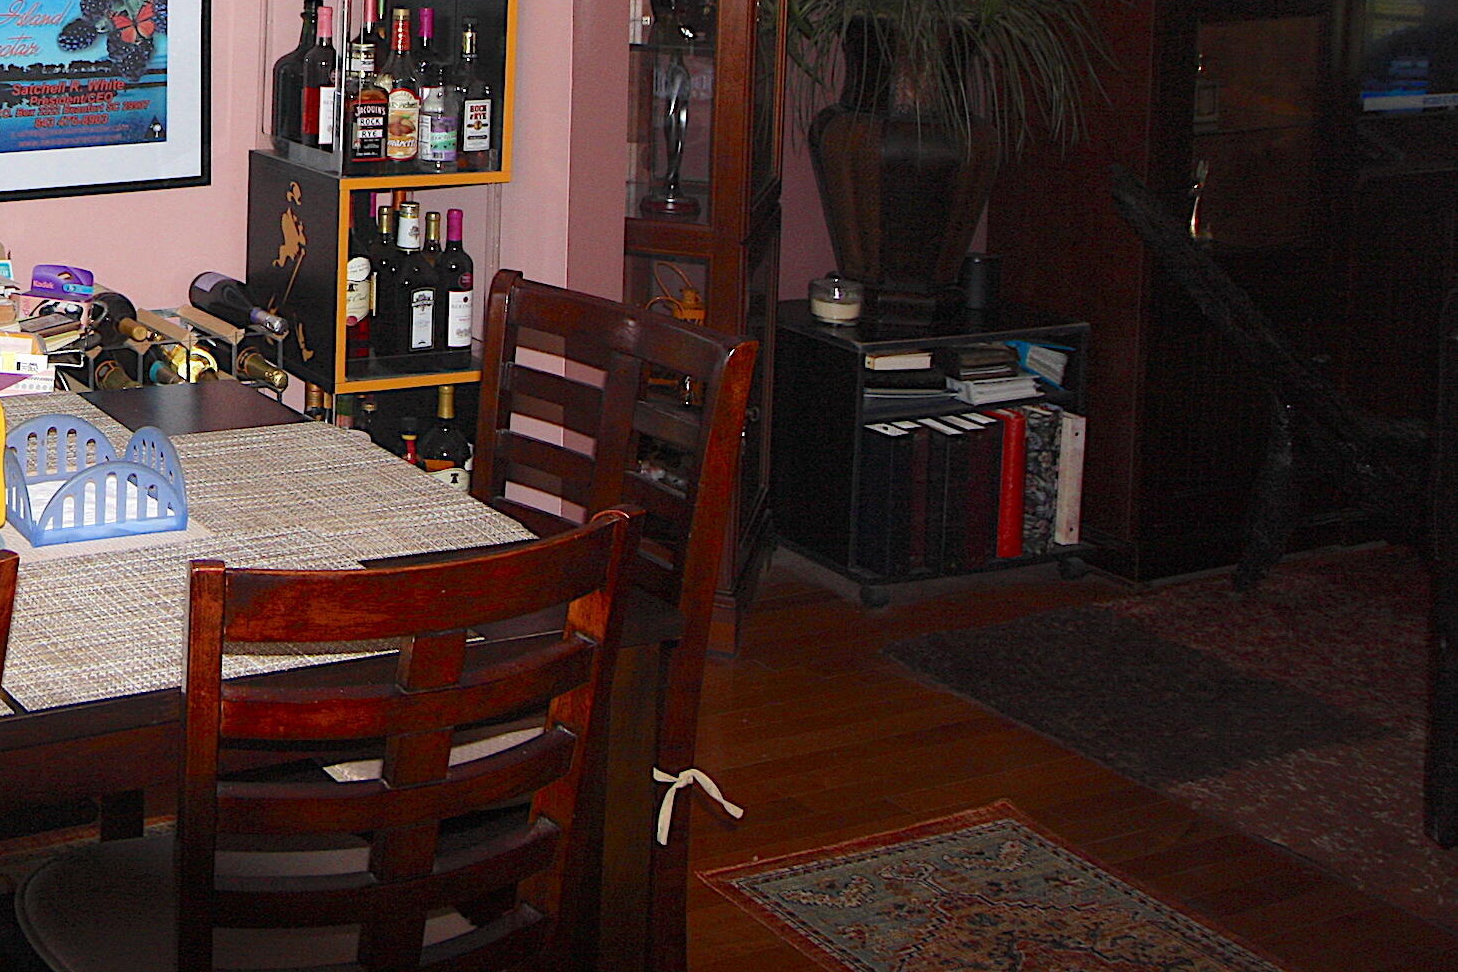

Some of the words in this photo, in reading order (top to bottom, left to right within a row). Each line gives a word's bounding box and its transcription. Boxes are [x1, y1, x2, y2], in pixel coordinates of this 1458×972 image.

[12, 82, 65, 96] Satchell
[69, 80, 82, 92] R.
[87, 78, 126, 91] White
[29, 92, 114, 106] President/CEO
[16, 107, 36, 117] Box
[354, 105, 386, 116] JACQUIN'S
[33, 280, 54, 289] Kodak
